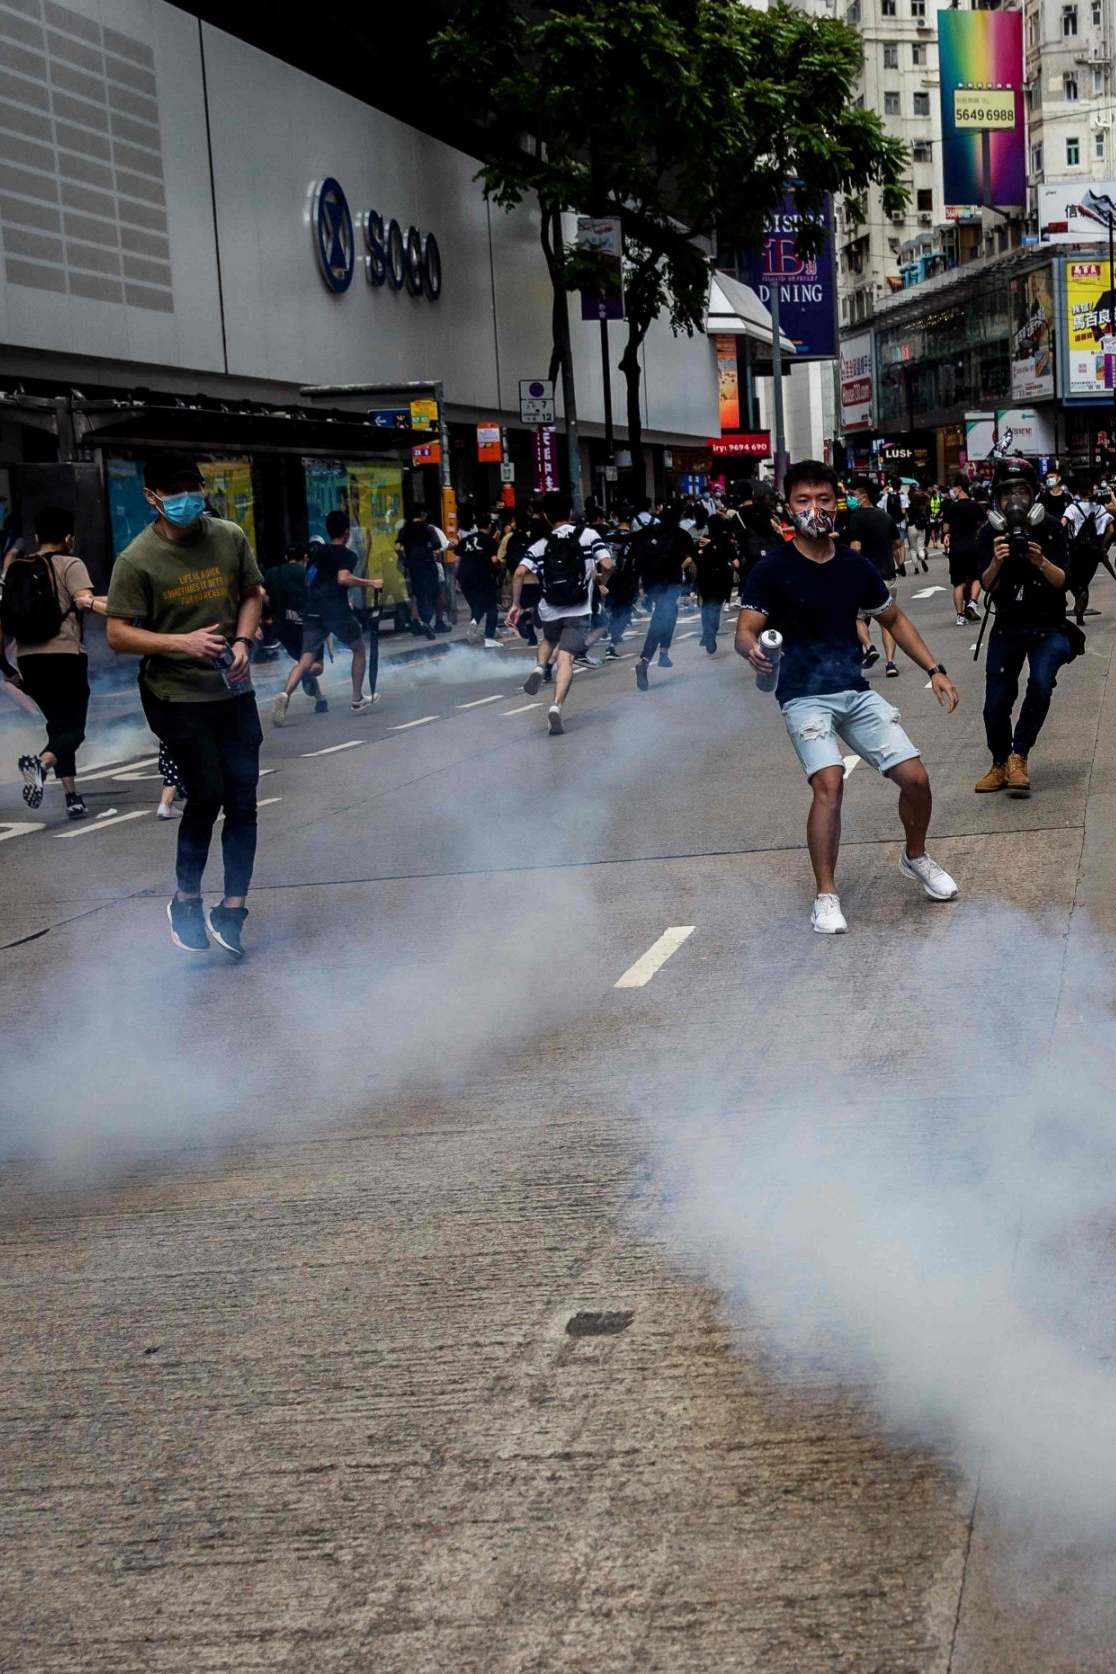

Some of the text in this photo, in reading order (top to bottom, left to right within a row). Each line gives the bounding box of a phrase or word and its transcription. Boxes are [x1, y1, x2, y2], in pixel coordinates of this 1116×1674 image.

[956, 109, 1014, 121] 5649 6988
[362, 209, 441, 301] SOGO
[759, 284, 823, 302] DNING
